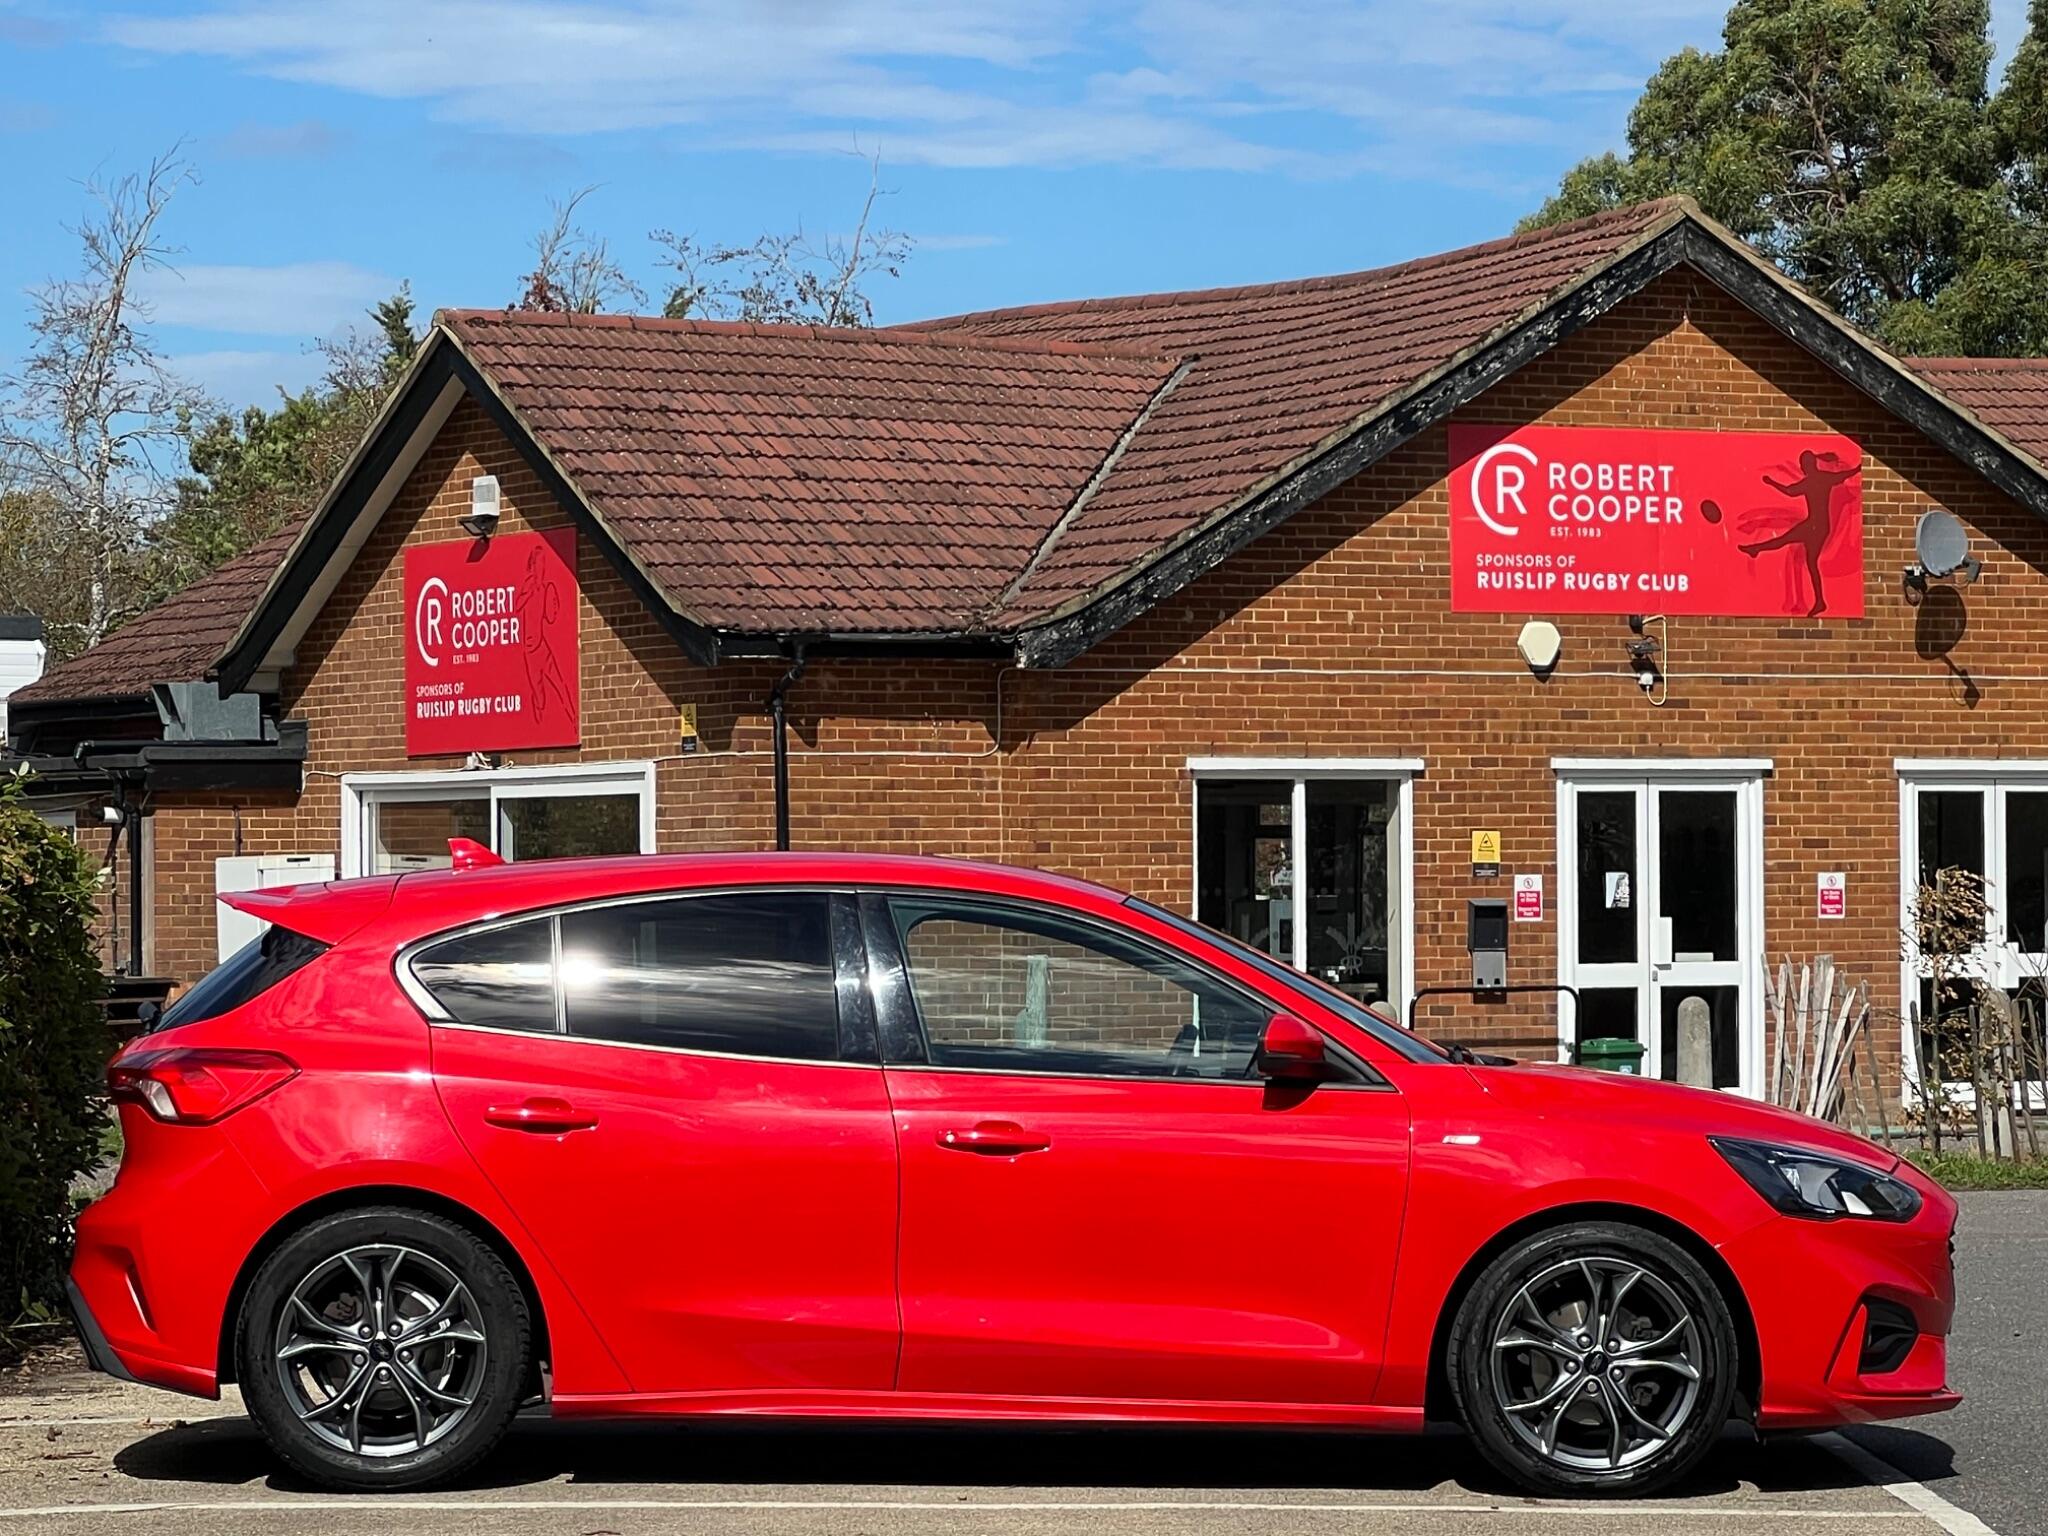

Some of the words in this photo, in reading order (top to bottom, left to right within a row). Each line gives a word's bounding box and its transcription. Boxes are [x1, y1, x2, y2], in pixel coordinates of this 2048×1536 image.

[1548, 462, 1675, 492] ROBERT
[1548, 495, 1684, 524] COOPER
[1550, 526, 1572, 537] EST.
[1577, 527, 1601, 538] 1983
[1476, 554, 1552, 568] SPONSORS
[1556, 554, 1576, 568] OF
[1477, 572, 1557, 590] RUISLIP
[1563, 573, 1631, 591] RUGBY
[1637, 573, 1689, 592] CLUB
[452, 586, 515, 619] ROBERT
[451, 617, 520, 649] COOPER
[452, 655, 465, 664] EST.
[416, 683, 453, 698] SPONSORS
[454, 682, 465, 695] OF
[416, 699, 455, 719] RUISLIP
[458, 697, 492, 716] RUGBY
[494, 695, 521, 712] CLUB
